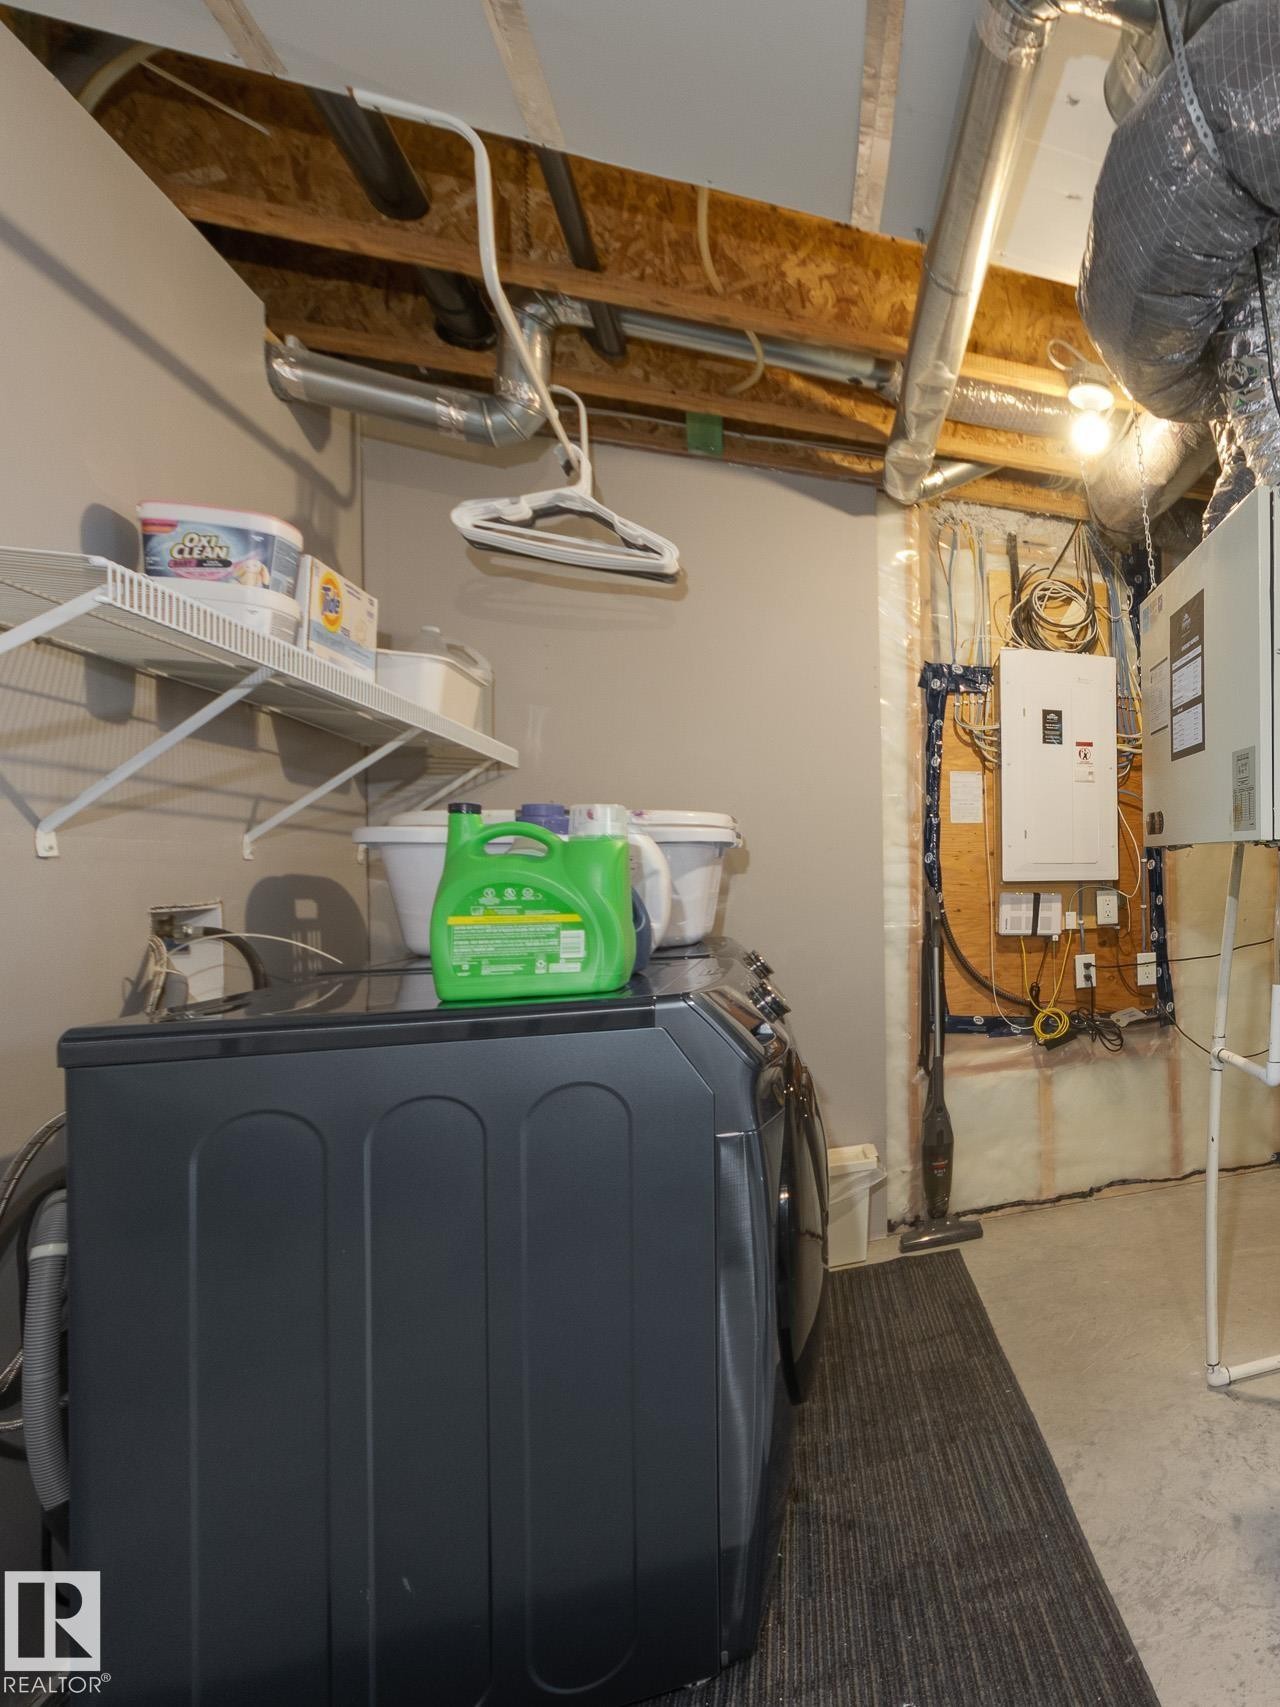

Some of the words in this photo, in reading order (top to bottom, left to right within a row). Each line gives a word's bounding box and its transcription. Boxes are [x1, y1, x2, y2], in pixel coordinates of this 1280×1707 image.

[183, 532, 220, 548] OXI
[170, 543, 230, 560] CLEAN
[321, 585, 341, 616] Tide
